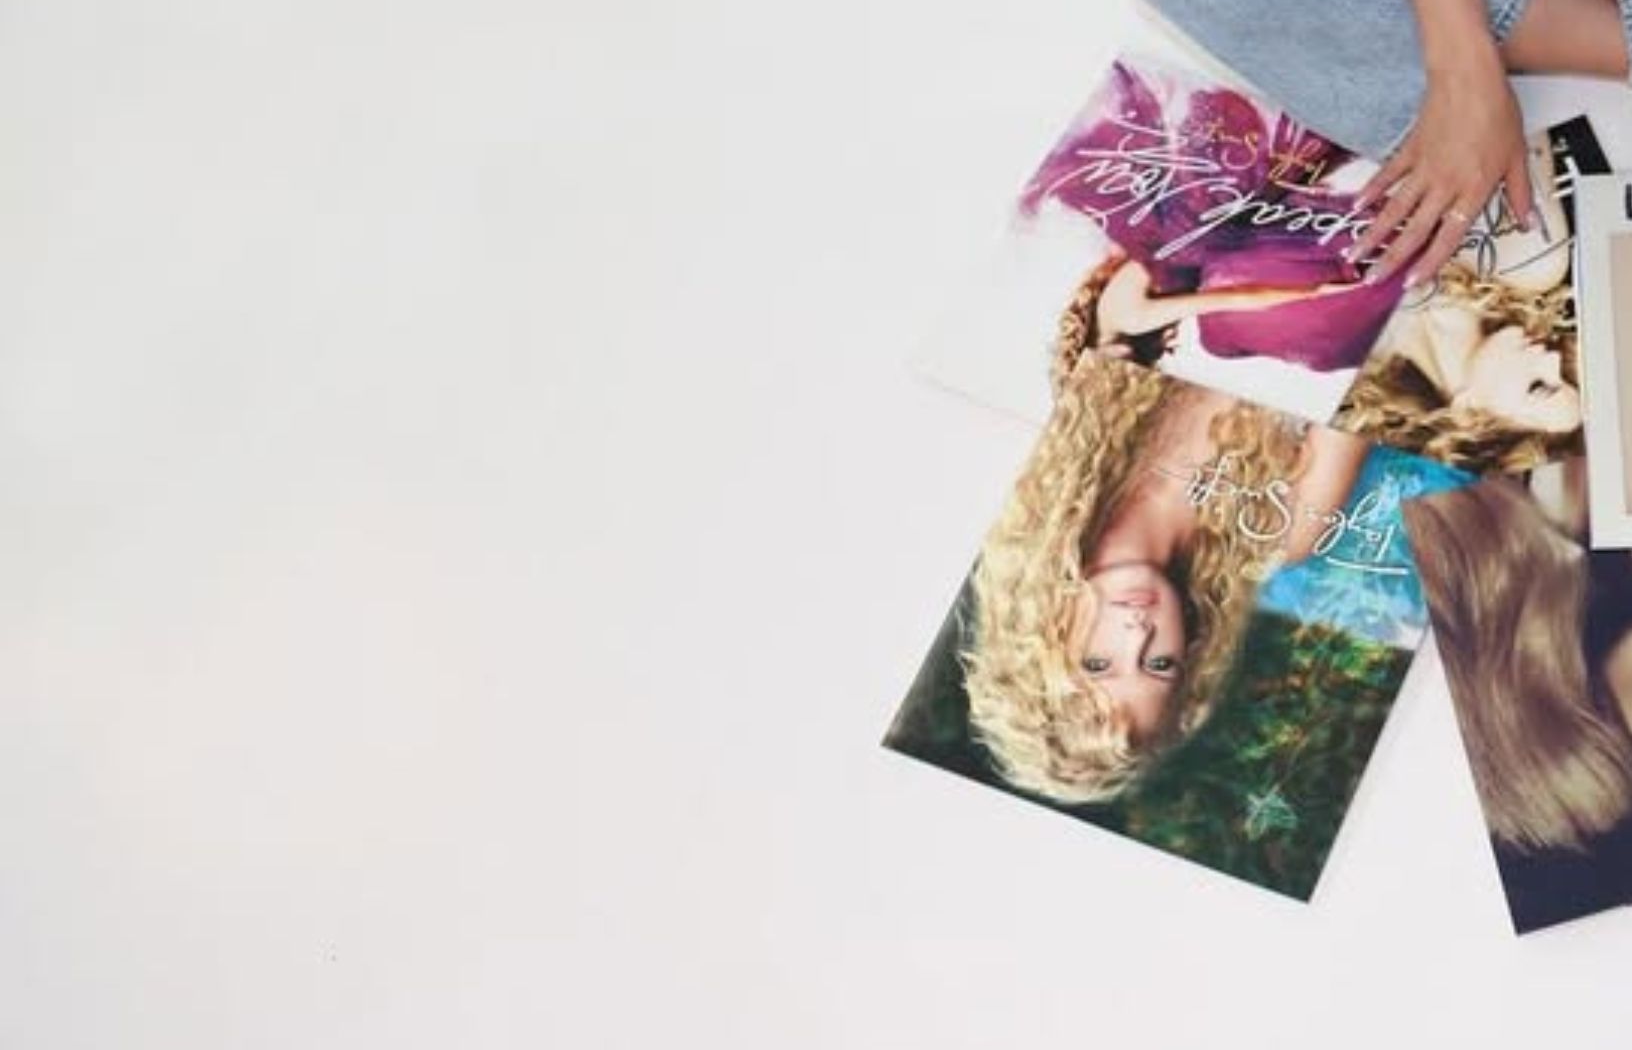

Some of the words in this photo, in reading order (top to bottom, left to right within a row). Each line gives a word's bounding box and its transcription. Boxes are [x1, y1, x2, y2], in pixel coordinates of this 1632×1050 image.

[1044, 152, 1186, 227] Now
[1184, 450, 1293, 540] Swift
[1307, 487, 1409, 576] Taylor
